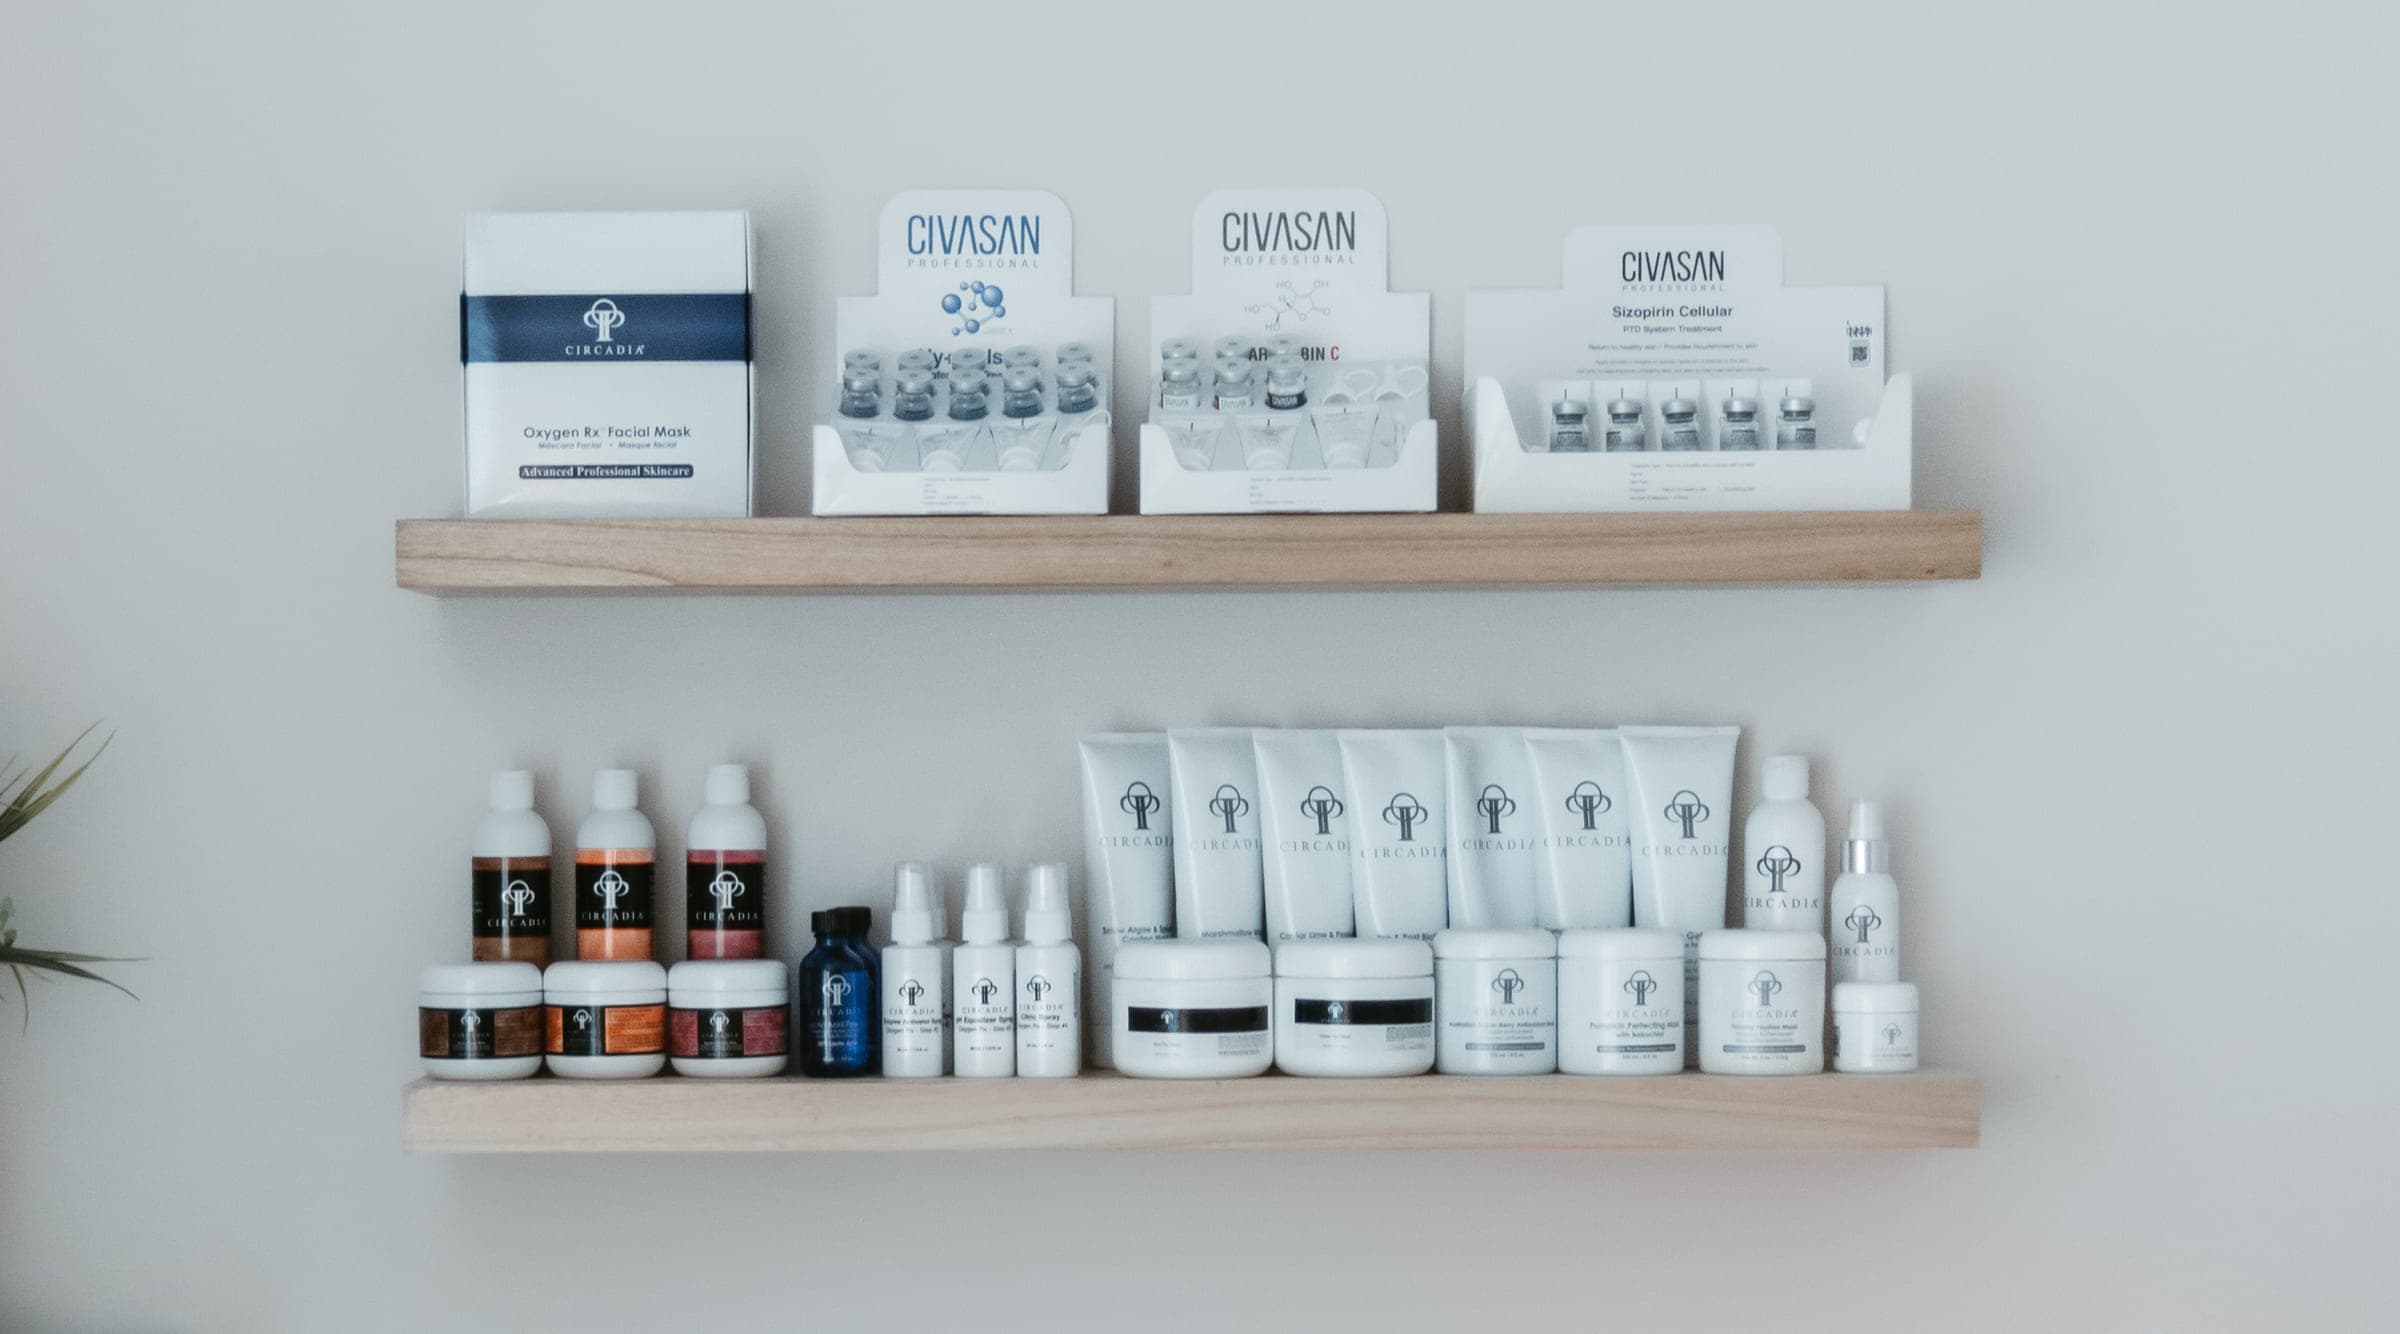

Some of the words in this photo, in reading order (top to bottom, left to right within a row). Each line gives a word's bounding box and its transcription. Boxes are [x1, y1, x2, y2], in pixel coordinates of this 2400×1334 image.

[907, 214, 1040, 256] CIVASAN
[1221, 211, 1356, 252] CIVASAN
[907, 258, 1040, 269] PROFESSIONAL
[1222, 254, 1356, 266] PROFESSIONAL
[1621, 250, 1725, 282] CIVASAN
[1621, 283, 1725, 293] PROFESSIONAL
[1612, 305, 1675, 321] Sizopirin
[1679, 304, 1734, 318] Cellular
[1679, 324, 1723, 333] Treatment
[565, 344, 645, 356] CIRCADIA
[1330, 346, 1340, 361] C
[524, 427, 579, 441] Oxygen
[584, 427, 600, 438] Rx
[608, 426, 650, 438] Facial
[654, 426, 692, 438] Mask
[521, 466, 574, 478] Advanced
[577, 466, 641, 477] Professional
[643, 466, 690, 477] Skincare
